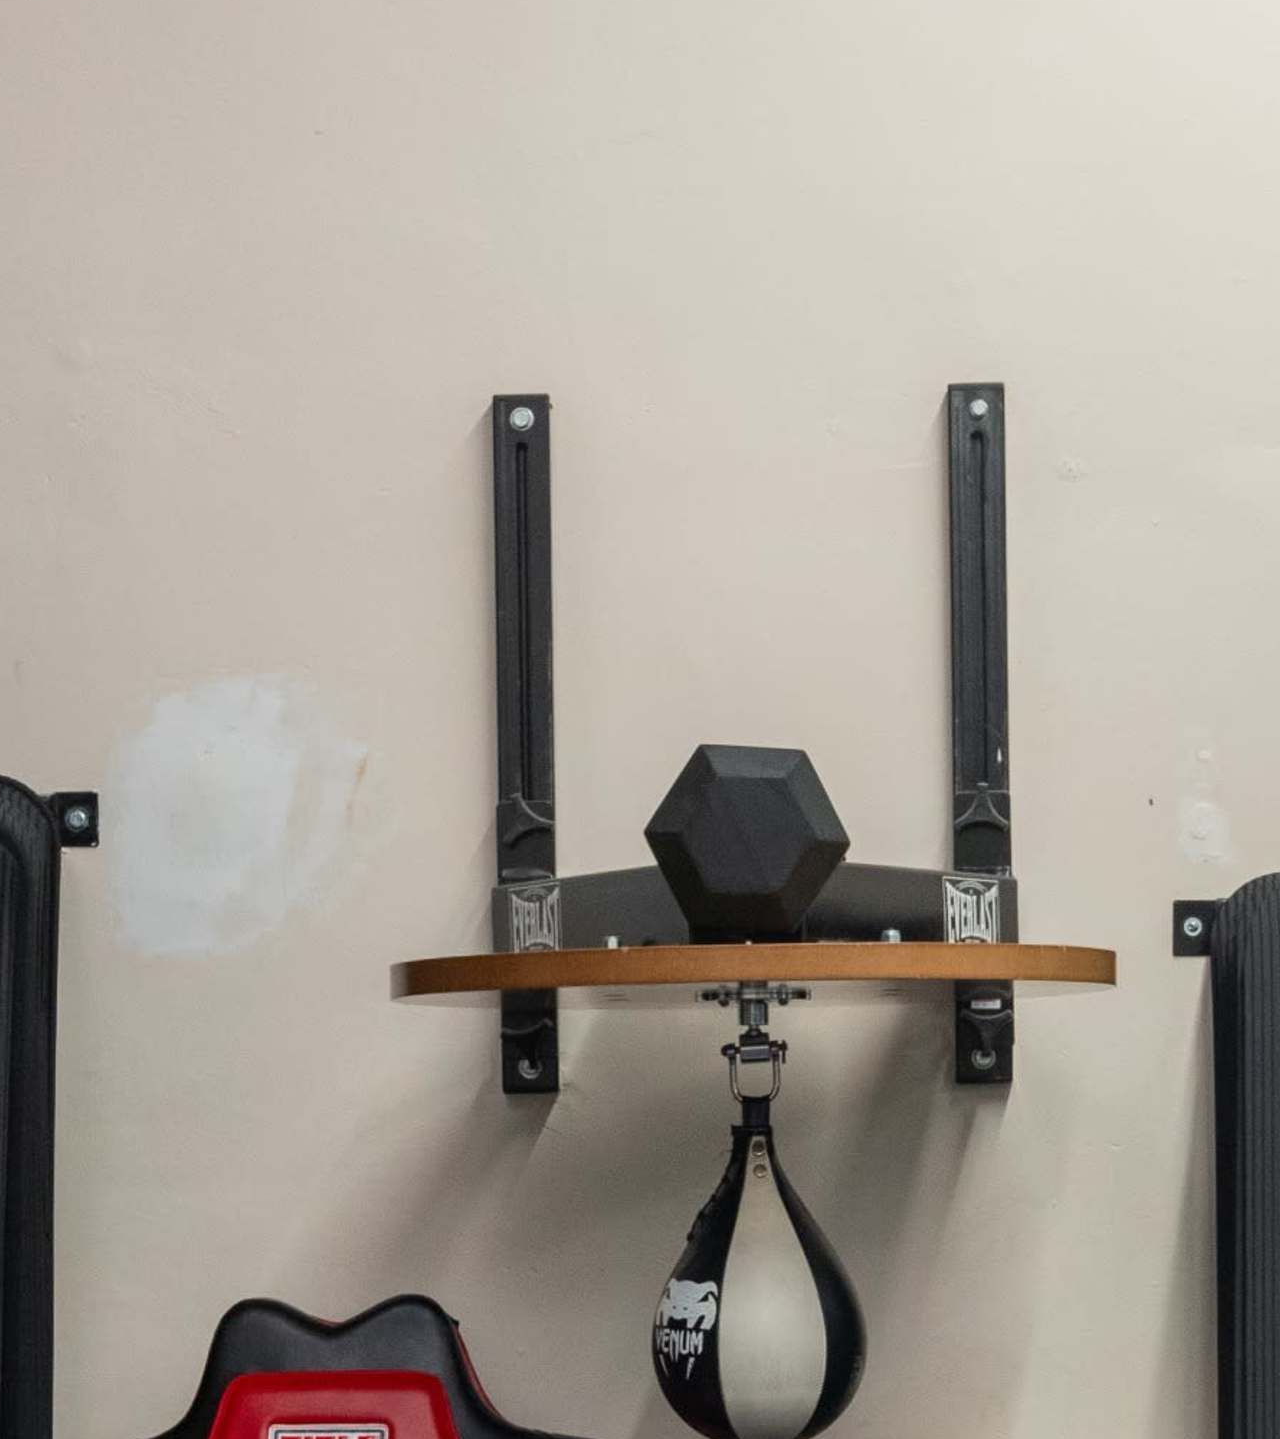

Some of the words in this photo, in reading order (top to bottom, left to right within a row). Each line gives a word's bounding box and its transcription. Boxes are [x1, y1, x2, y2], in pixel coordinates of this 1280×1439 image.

[512, 887, 560, 954] EVERLAST
[945, 880, 998, 944] EVERLAST
[656, 1327, 704, 1362] VENUM
